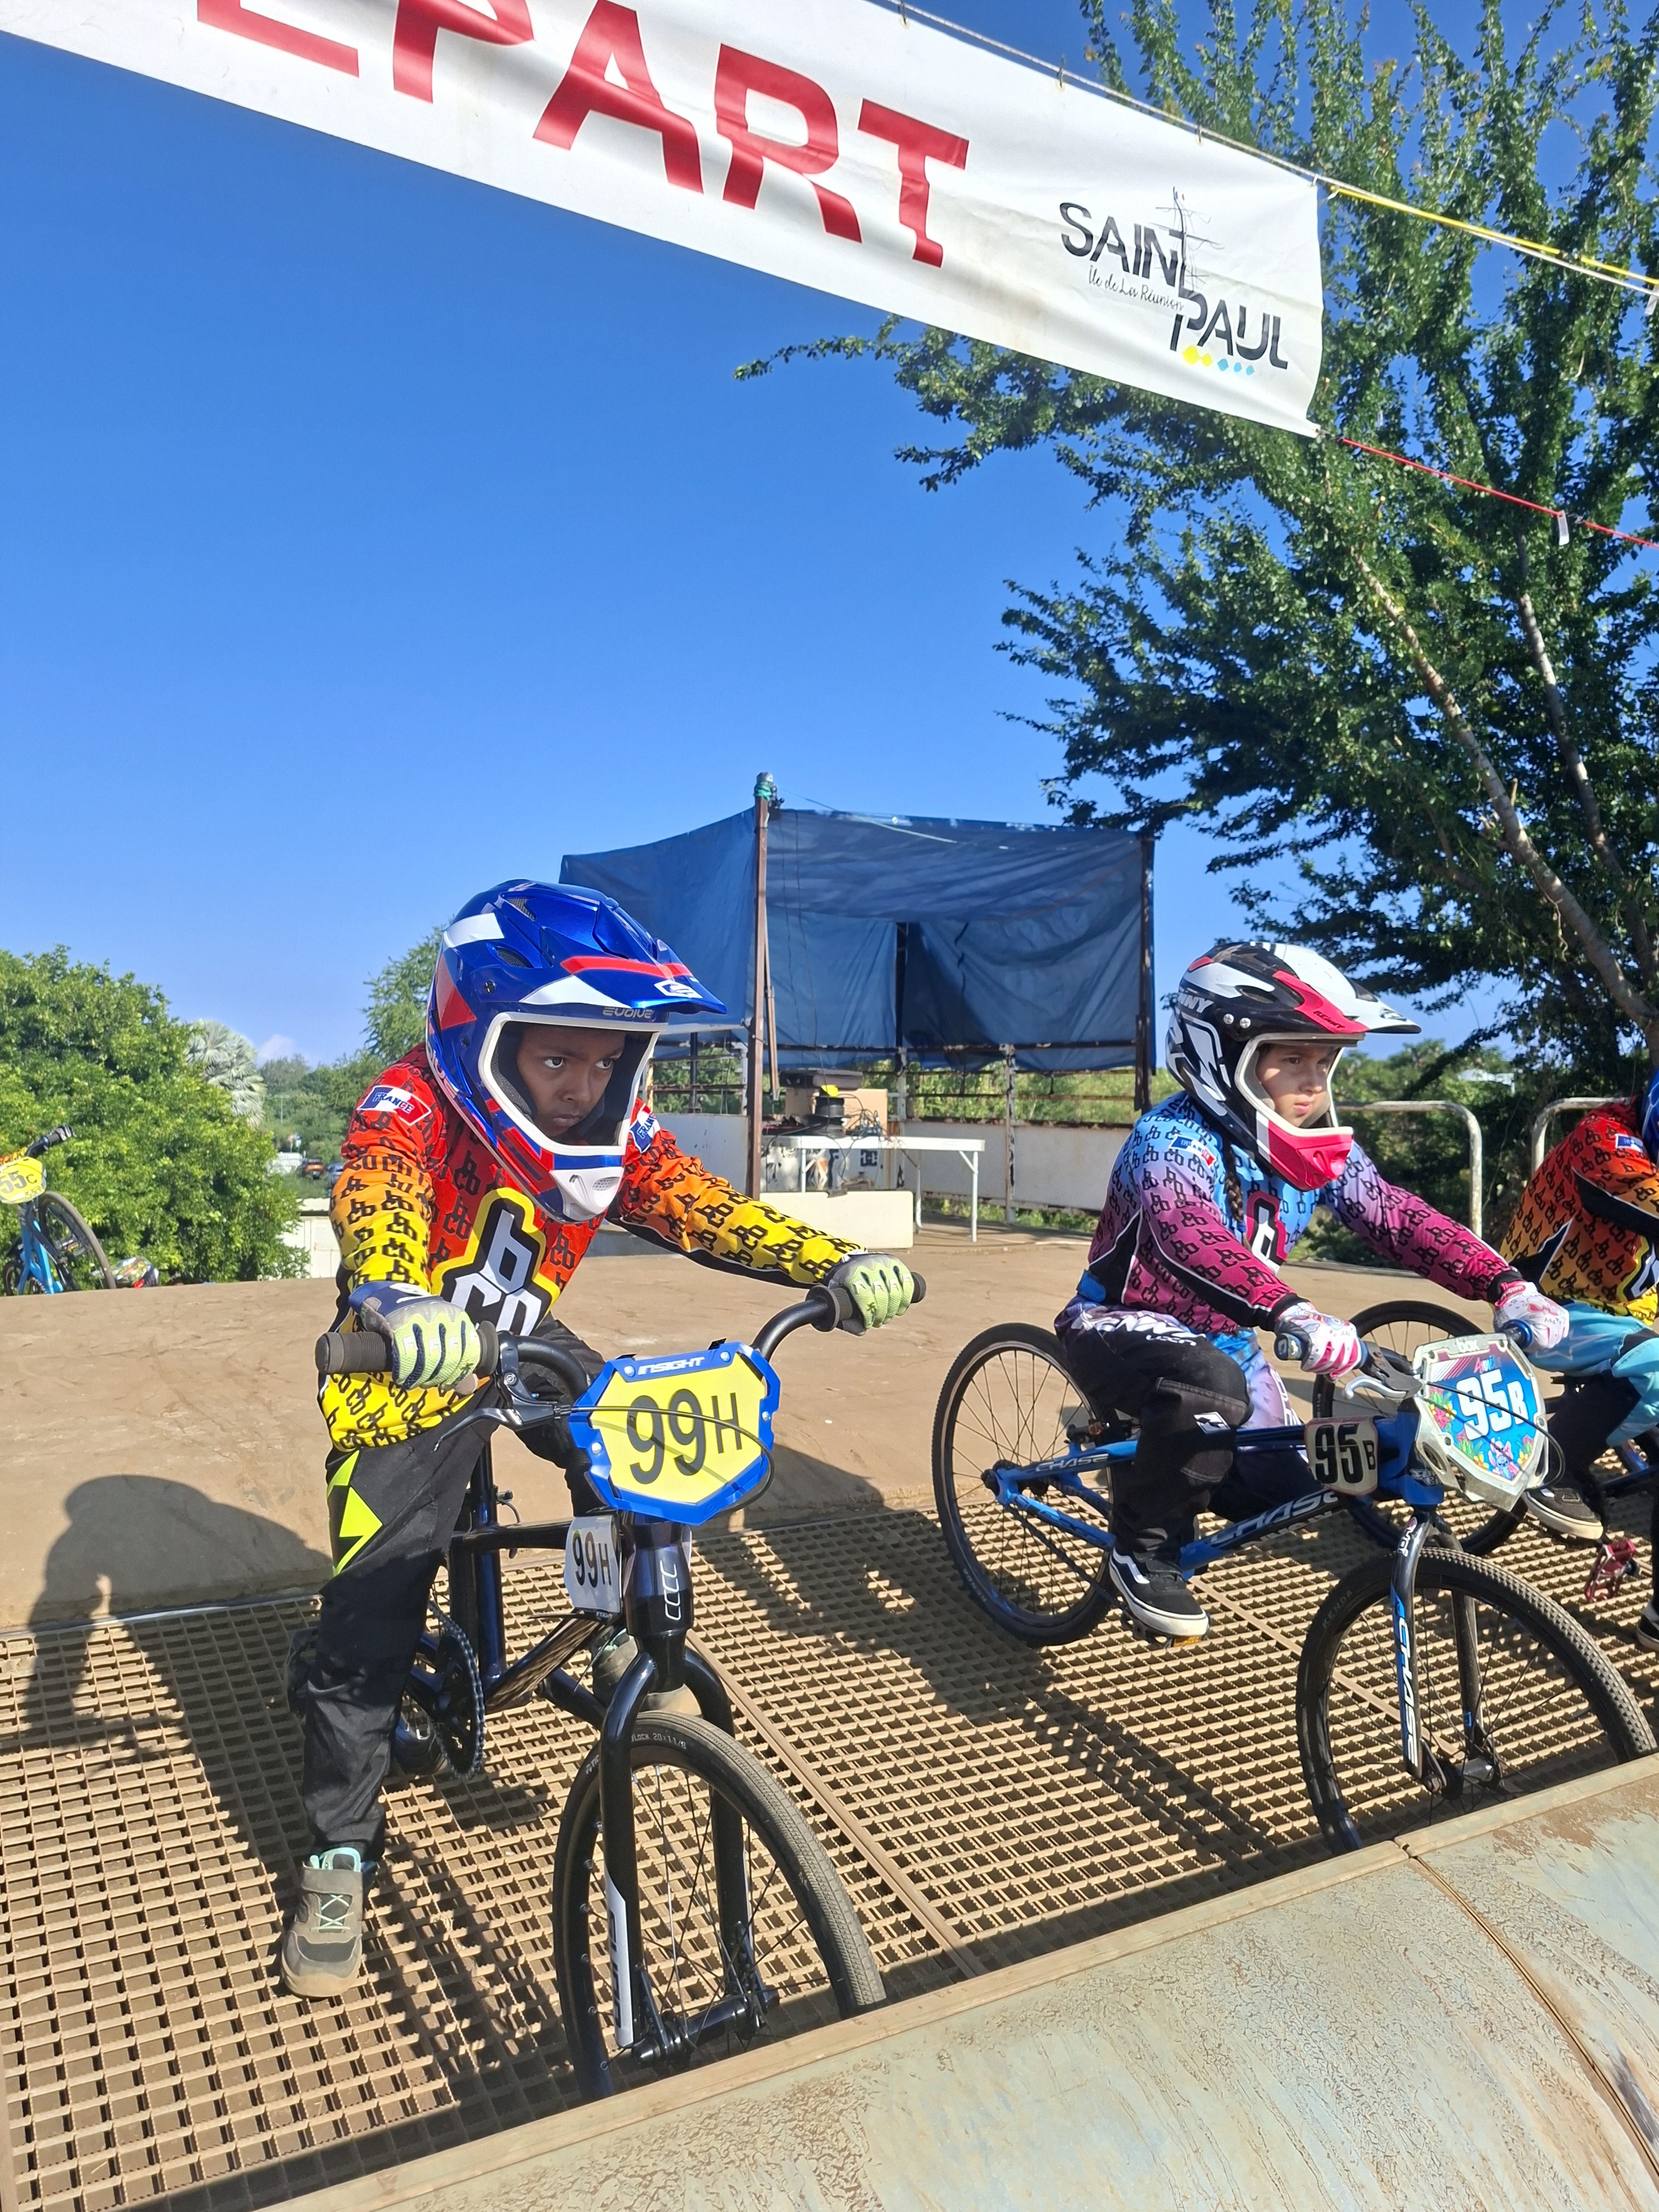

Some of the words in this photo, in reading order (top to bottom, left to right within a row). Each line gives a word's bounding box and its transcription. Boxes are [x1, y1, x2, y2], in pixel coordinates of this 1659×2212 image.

[197, 0, 969, 268] PART
[1059, 201, 1189, 293] SAINT
[1170, 289, 1288, 370] PAUL
[372, 1092, 415, 1114] FRANCE
[638, 1356, 705, 1375] INSIGHT
[1456, 1337, 1480, 1353] box
[627, 1388, 743, 1485] 99H
[1455, 1368, 1529, 1441] 95B
[1036, 1453, 1109, 1472] CHASE
[1314, 1423, 1376, 1485] 95B
[572, 1530, 612, 1588] 99H
[1399, 1616, 1418, 1768] CHASE
